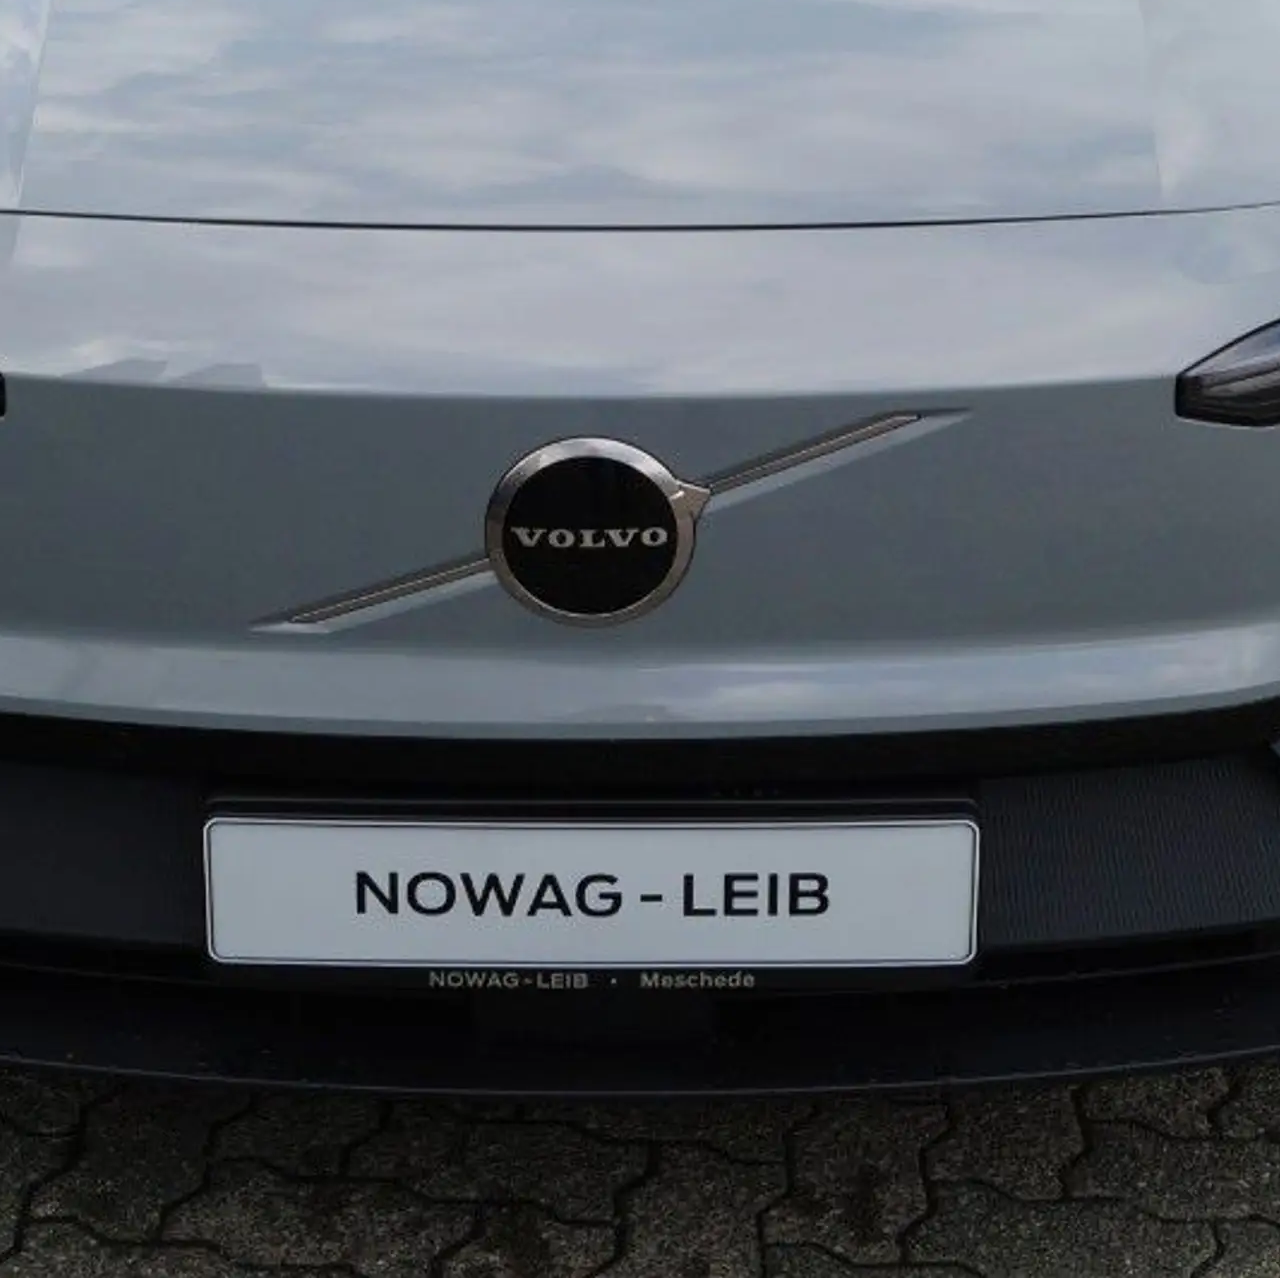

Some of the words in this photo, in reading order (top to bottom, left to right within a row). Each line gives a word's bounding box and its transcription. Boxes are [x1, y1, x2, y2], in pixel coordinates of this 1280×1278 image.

[510, 526, 668, 548] VOLVO
[355, 872, 622, 918] NOWAG
[683, 872, 830, 917] LEIB
[639, 971, 755, 989] Meschede
